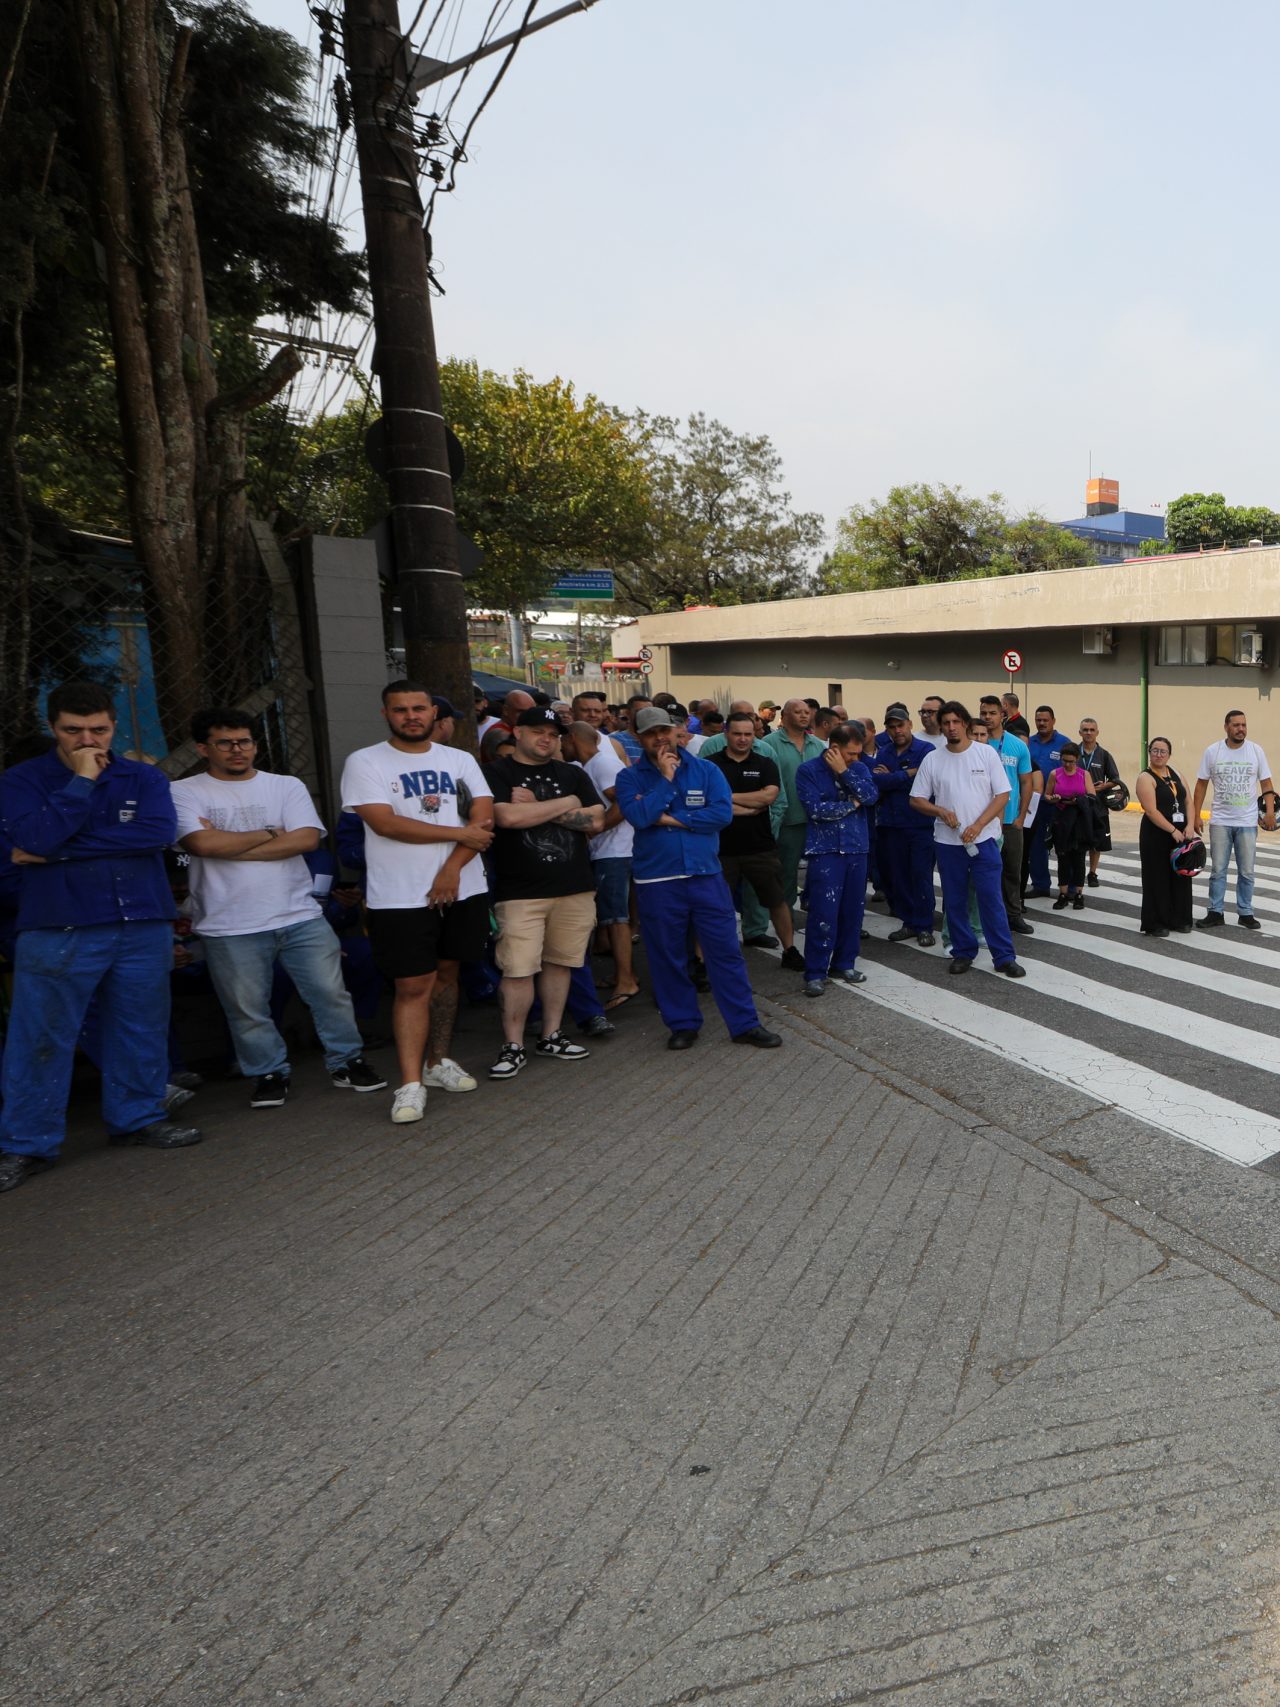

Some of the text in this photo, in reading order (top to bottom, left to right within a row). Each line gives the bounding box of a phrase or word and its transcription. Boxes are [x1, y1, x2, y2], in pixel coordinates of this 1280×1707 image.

[1008, 655, 1017, 667] E
[1216, 766, 1253, 775] LEAVE
[1218, 775, 1250, 783] YOUR
[398, 769, 457, 800] NBA
